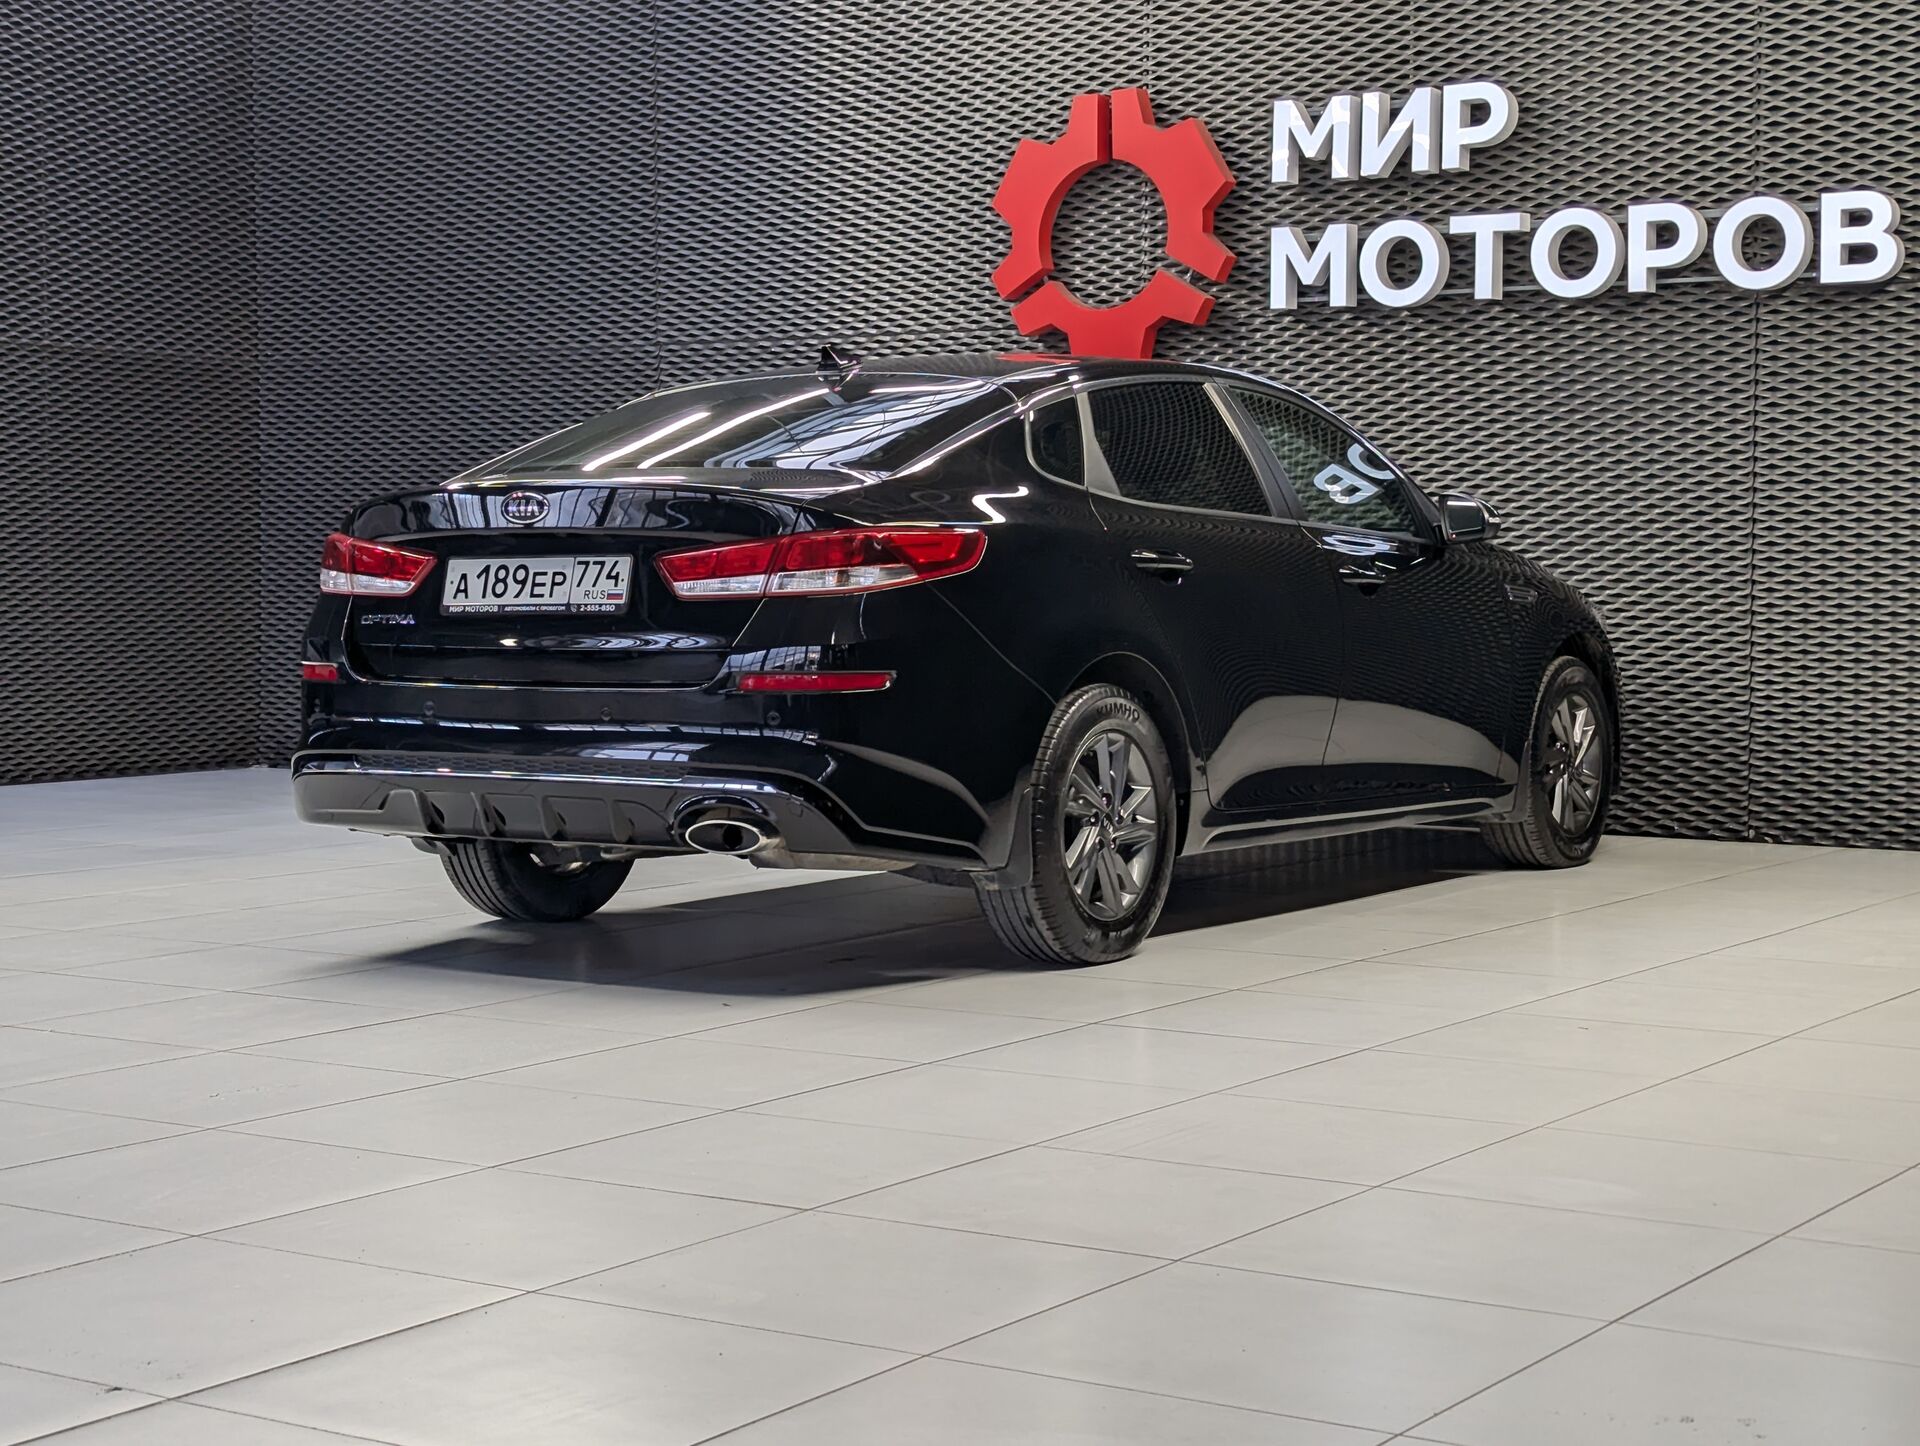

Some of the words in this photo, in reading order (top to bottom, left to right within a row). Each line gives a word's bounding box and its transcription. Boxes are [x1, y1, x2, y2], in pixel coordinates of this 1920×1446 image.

[1271, 81, 1519, 183] МИР
[1270, 191, 1905, 310] МОТОРОВ
[508, 499, 540, 517] KIA
[576, 560, 620, 588] 774
[583, 589, 607, 600] RUS
[464, 605, 499, 613] МОТОРОВ
[361, 614, 416, 625] OPTIMA
[1096, 702, 1140, 721] KUMHO
